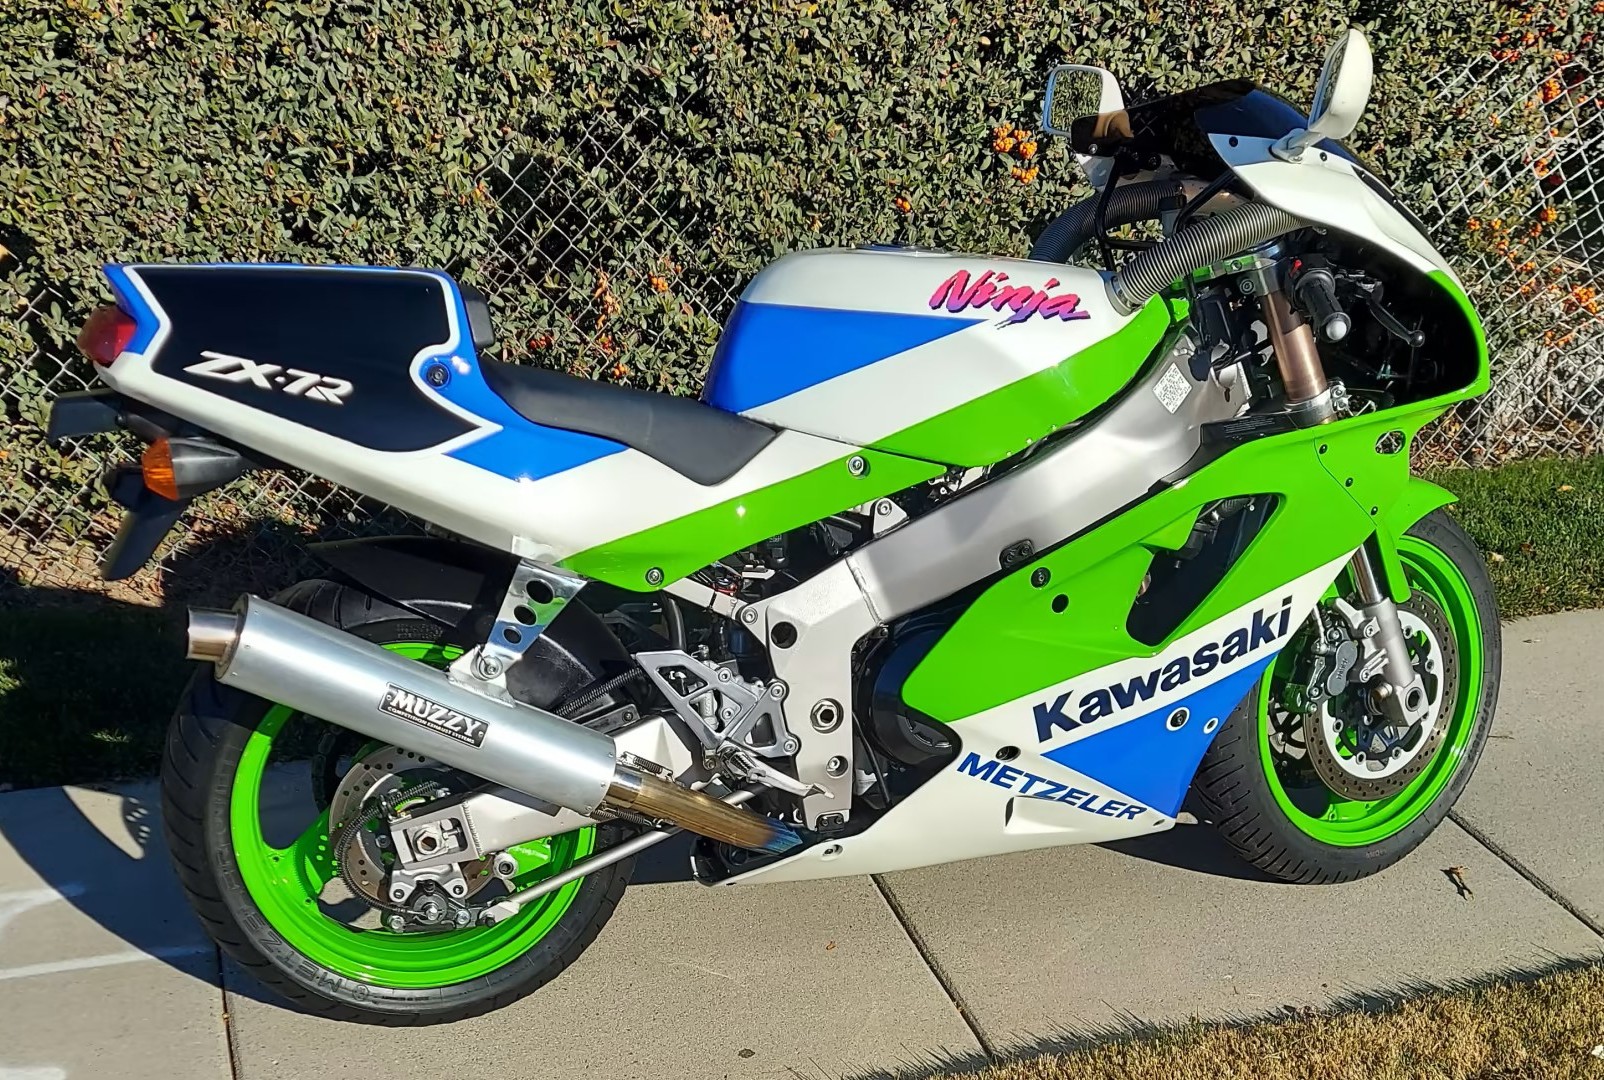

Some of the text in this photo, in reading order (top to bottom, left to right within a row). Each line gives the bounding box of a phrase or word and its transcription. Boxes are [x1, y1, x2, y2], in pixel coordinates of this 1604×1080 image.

[928, 269, 1091, 330] Ninja
[1033, 594, 1293, 743] Kawasaki
[387, 706, 475, 744] COMPETITION EXHAUST SYSTEMS
[389, 689, 482, 737] MUZZY
[956, 752, 1148, 820] METZELER
